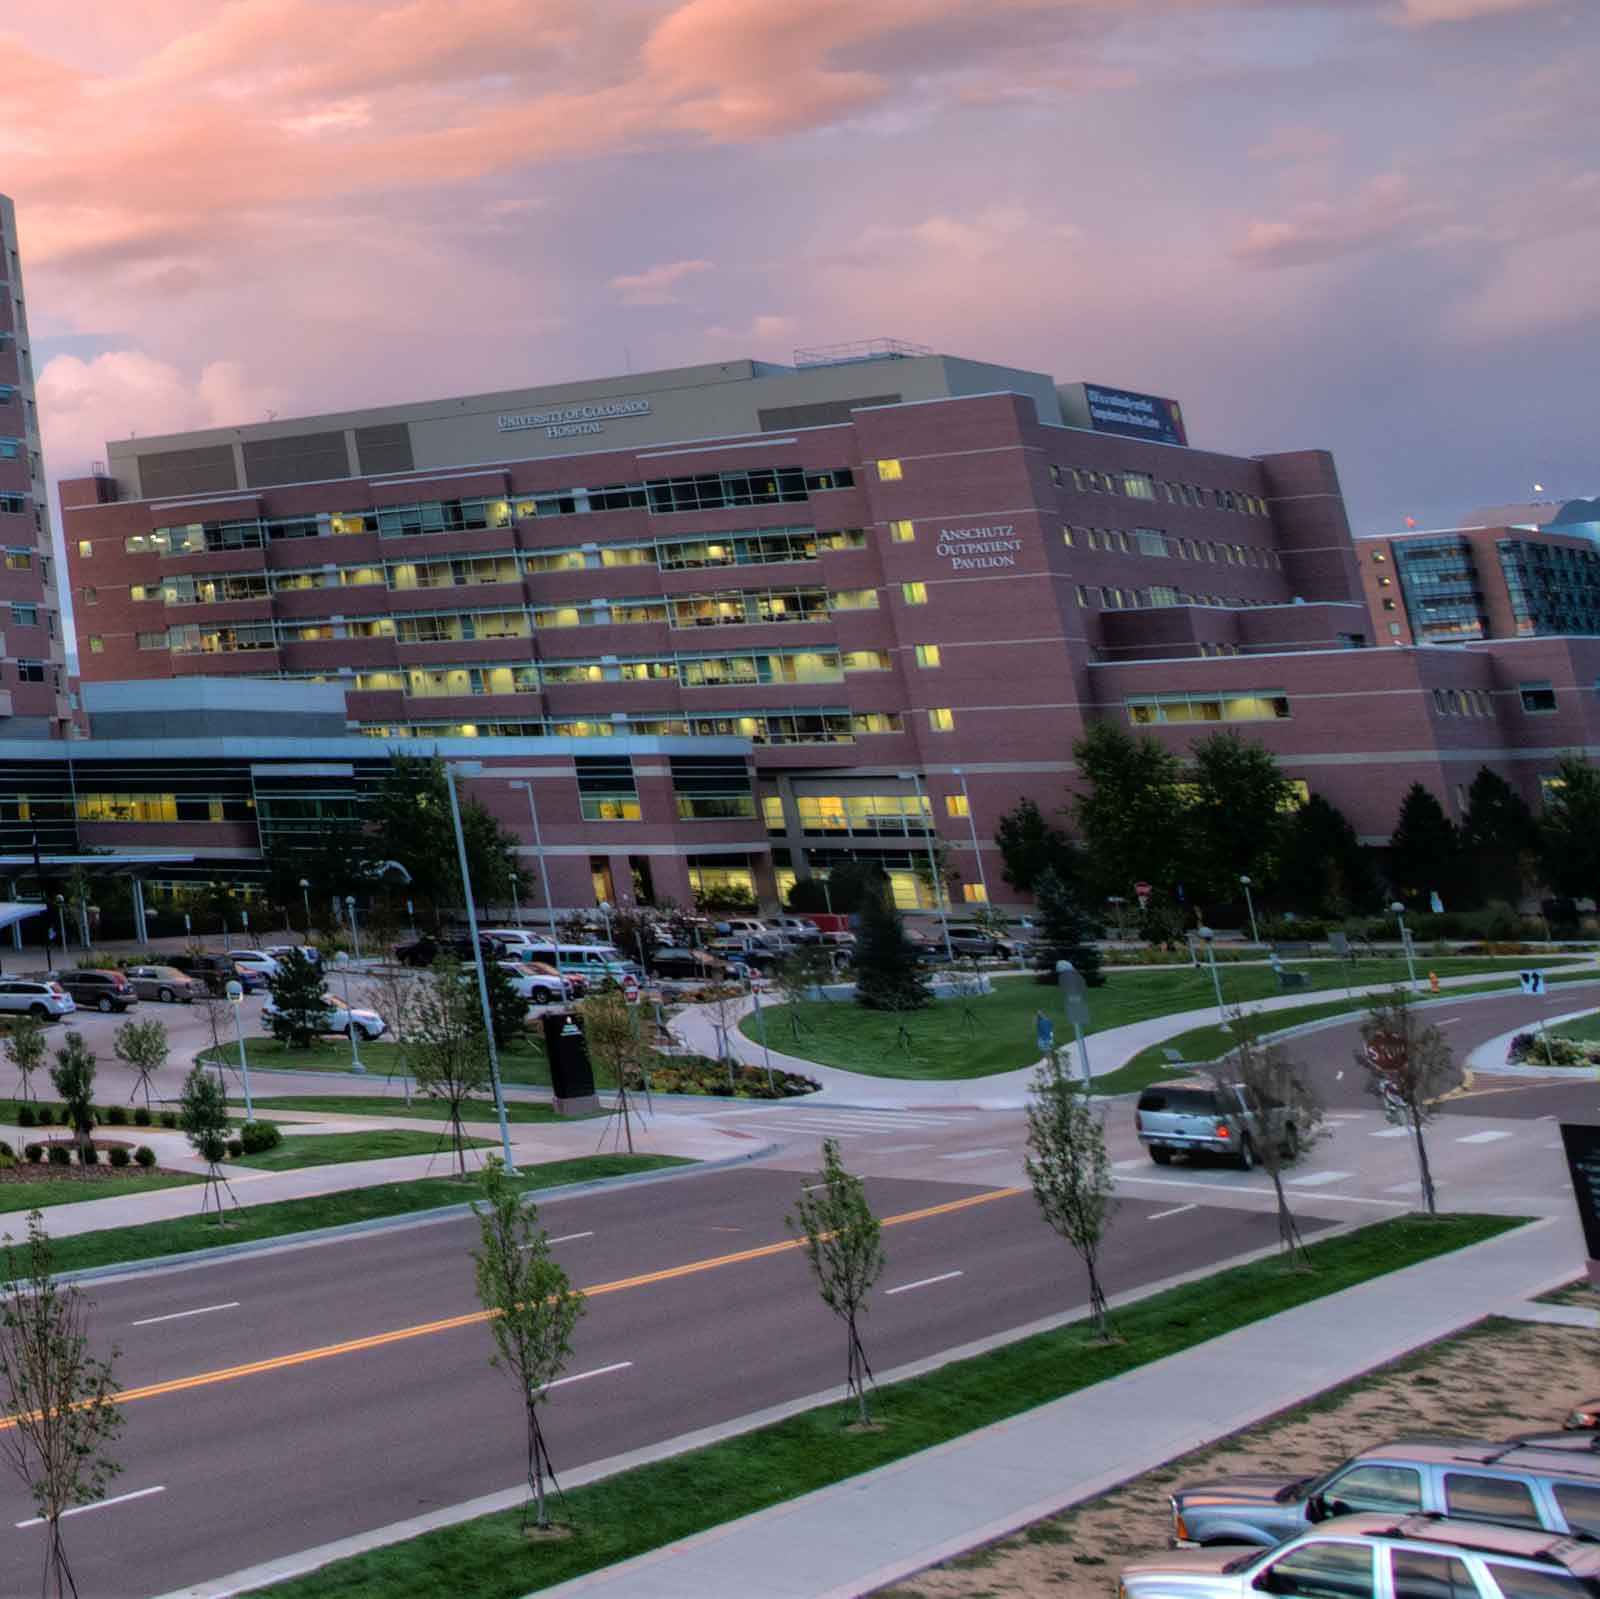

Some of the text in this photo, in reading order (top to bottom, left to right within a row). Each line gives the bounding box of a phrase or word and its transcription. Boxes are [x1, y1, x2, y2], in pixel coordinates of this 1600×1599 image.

[939, 525, 1016, 541] ANSCHUTZ
[936, 540, 1024, 556] OUTPATIENT
[951, 555, 1015, 570] PAVILION
